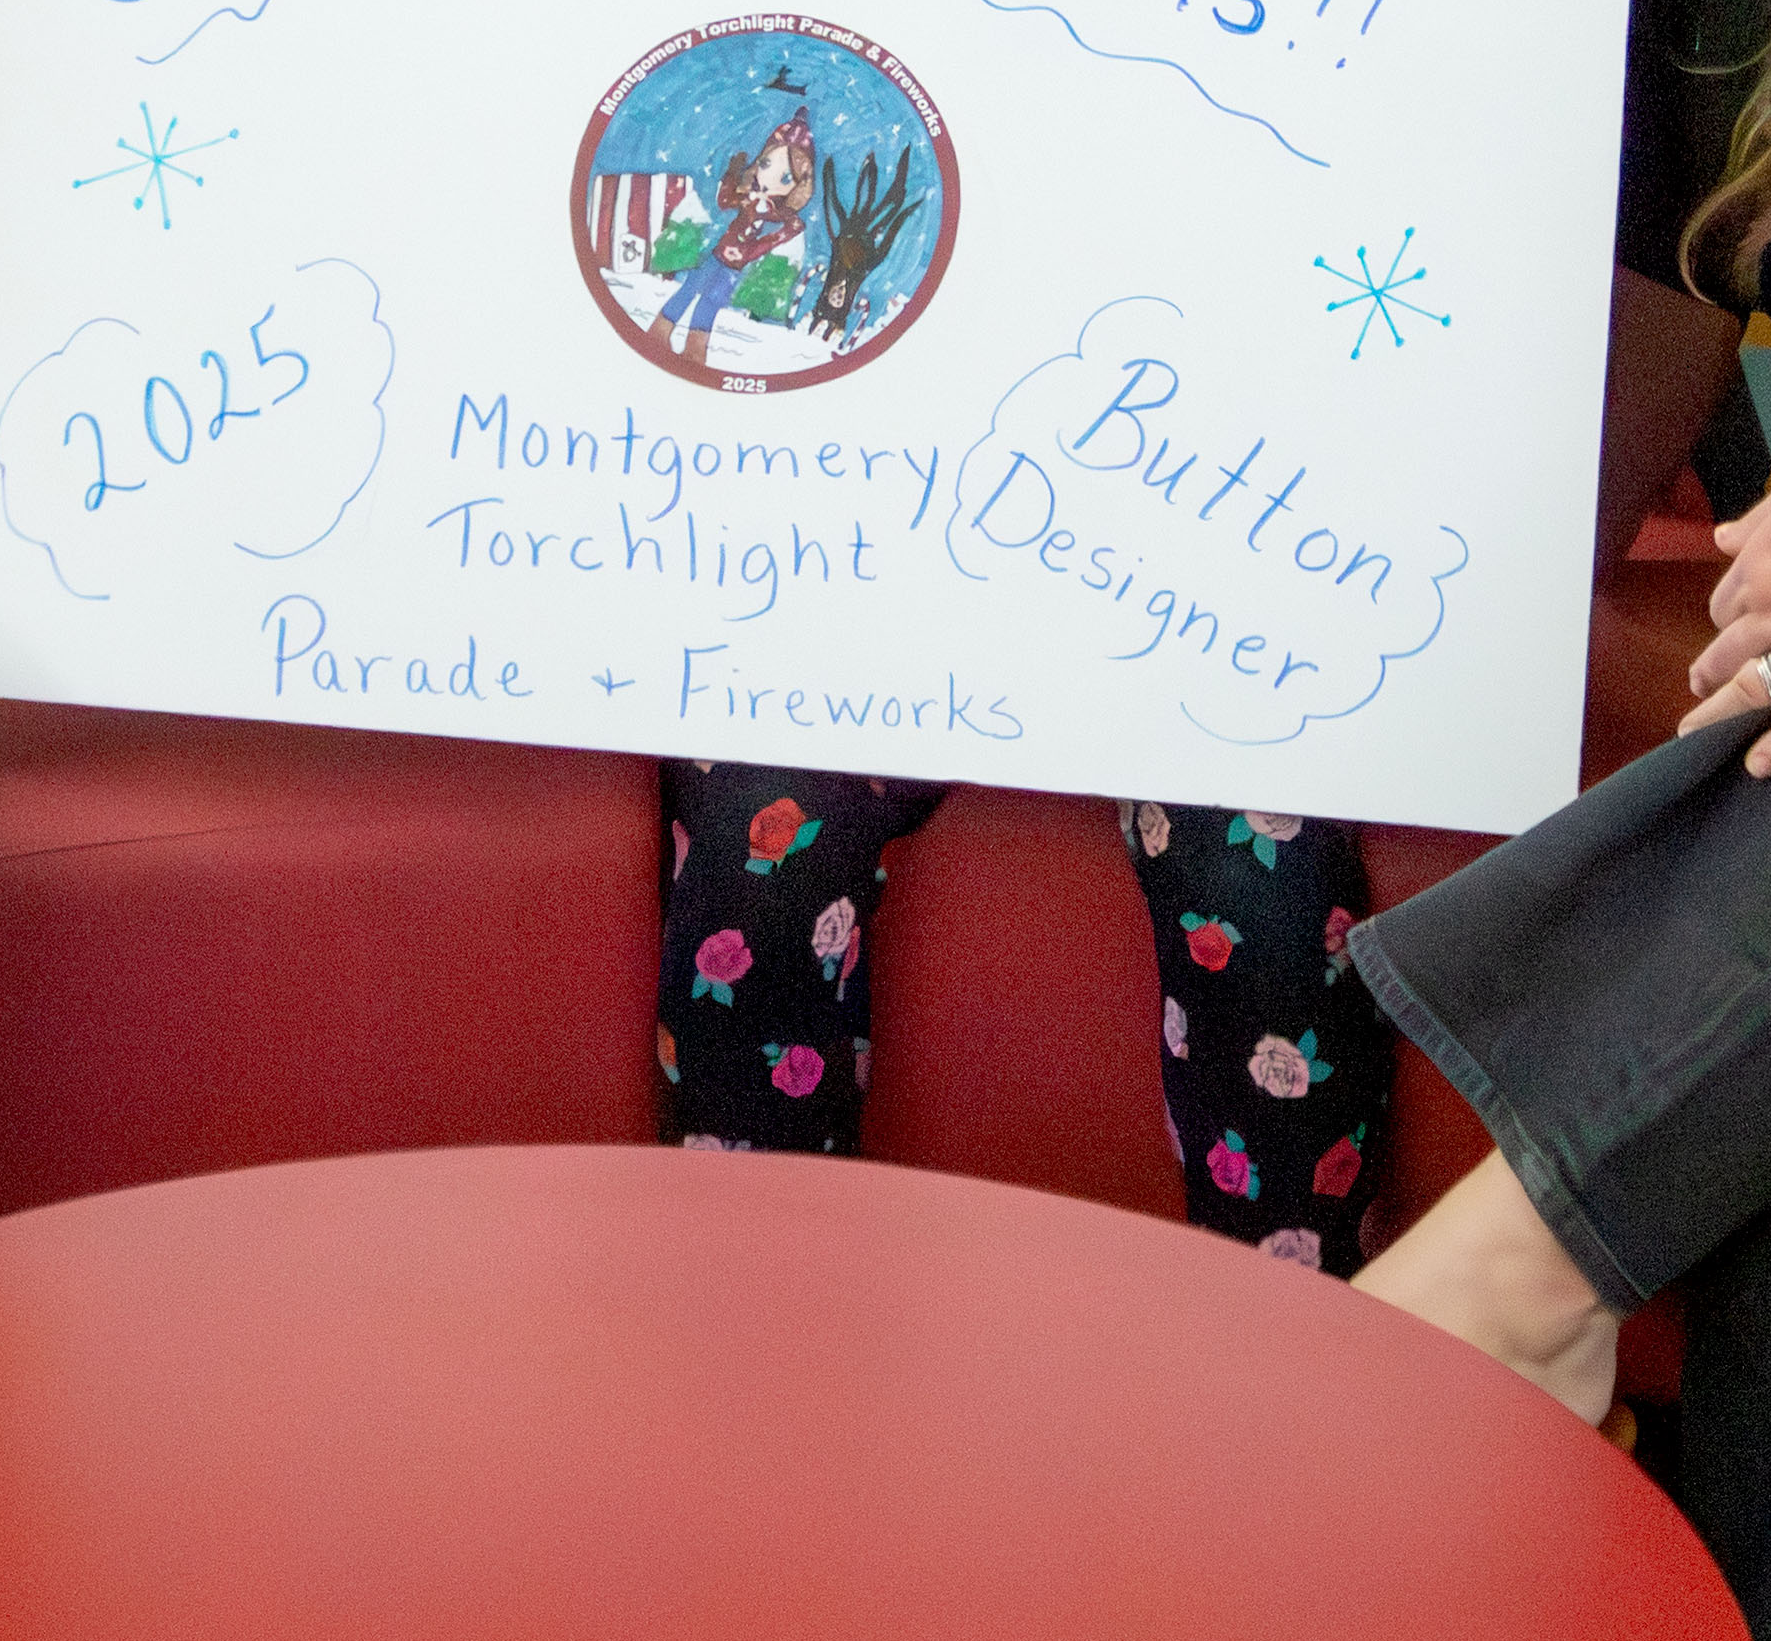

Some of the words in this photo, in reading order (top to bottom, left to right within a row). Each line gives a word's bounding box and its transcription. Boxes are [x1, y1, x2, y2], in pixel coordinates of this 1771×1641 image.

[600, 33, 693, 116] Montgomery
[695, 14, 795, 40] Torchlight
[799, 17, 864, 51] Parade
[865, 45, 882, 62] &
[881, 56, 942, 138] Fireworks
[62, 303, 309, 512] 2025
[722, 376, 768, 394] 2025
[450, 393, 940, 530] Montgomery
[1057, 358, 1392, 604] Button
[427, 497, 878, 622] Torchlight
[971, 451, 1318, 689] Designer
[261, 594, 535, 701] Parade
[680, 643, 1024, 741] Fireworks
